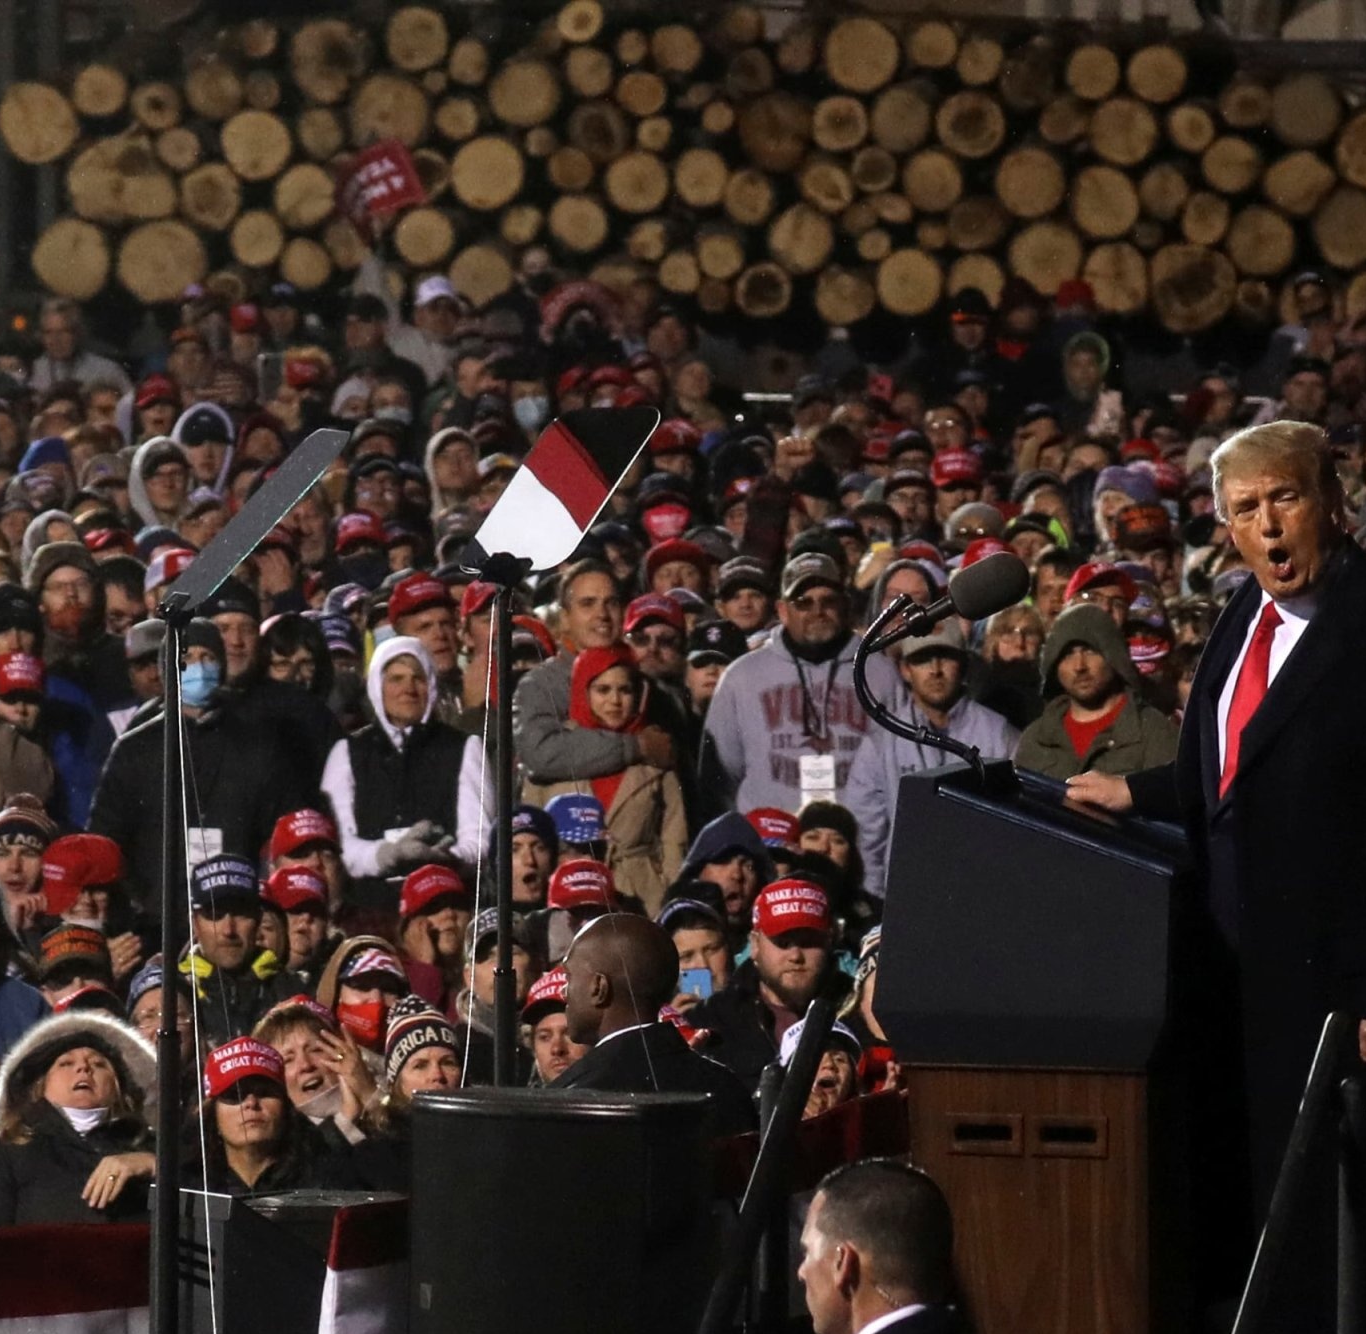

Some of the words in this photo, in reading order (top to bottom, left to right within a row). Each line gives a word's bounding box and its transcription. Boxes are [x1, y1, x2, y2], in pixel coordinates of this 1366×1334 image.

[766, 888, 792, 904] MAKE
[771, 902, 800, 917] GREAT
[386, 1025, 440, 1083] AMERICA
